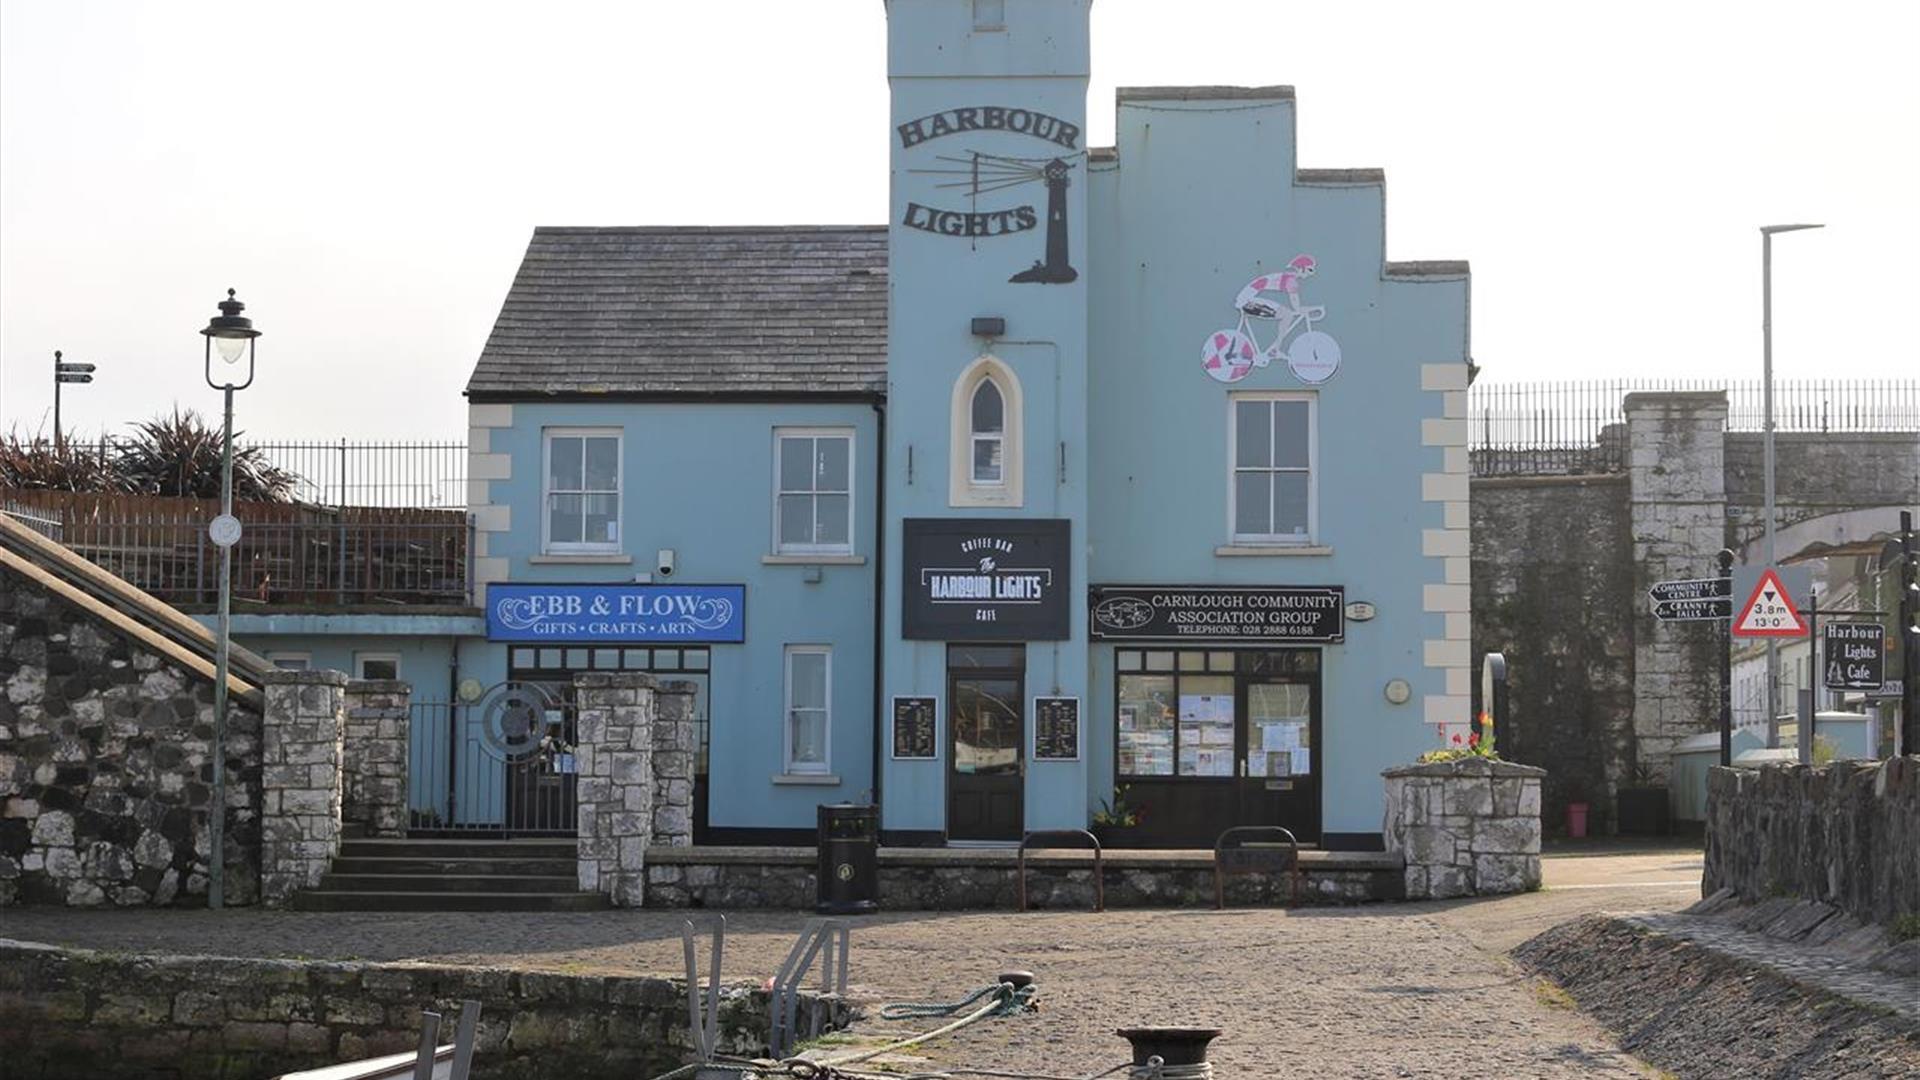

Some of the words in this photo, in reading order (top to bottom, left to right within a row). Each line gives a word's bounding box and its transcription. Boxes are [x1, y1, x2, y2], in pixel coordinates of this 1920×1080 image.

[897, 106, 1080, 150] HARBOUR
[903, 202, 1037, 237] LIGHTS
[961, 537, 991, 552] COFFEE
[995, 539, 1013, 552] BAR
[980, 557, 995, 573] The
[931, 575, 992, 598] HARBOUR
[995, 575, 1042, 598] LIGHTS
[1655, 582, 1709, 592] COMMUNITY
[1668, 590, 1701, 599] CENTRE
[529, 595, 582, 616] EBB
[590, 595, 610, 616] &
[619, 595, 702, 616] FLOW
[1152, 595, 1243, 608] CARNLOUGH
[1247, 596, 1338, 608] COMMUNITY
[1670, 602, 1708, 611] CRANNY
[1168, 612, 1266, 624] ASSOCIATION
[1269, 612, 1321, 624] GROUP
[1676, 609, 1702, 617] FALLS
[533, 622, 577, 634] GIFTS
[589, 622, 646, 634] CRAFTS
[657, 622, 696, 634] ARTS
[1177, 625, 1240, 634] TELEPHONE:
[1242, 625, 1261, 634] 028
[1828, 625, 1881, 638] Harbour
[1845, 644, 1876, 660] Lights
[1847, 664, 1870, 679] Cafe
